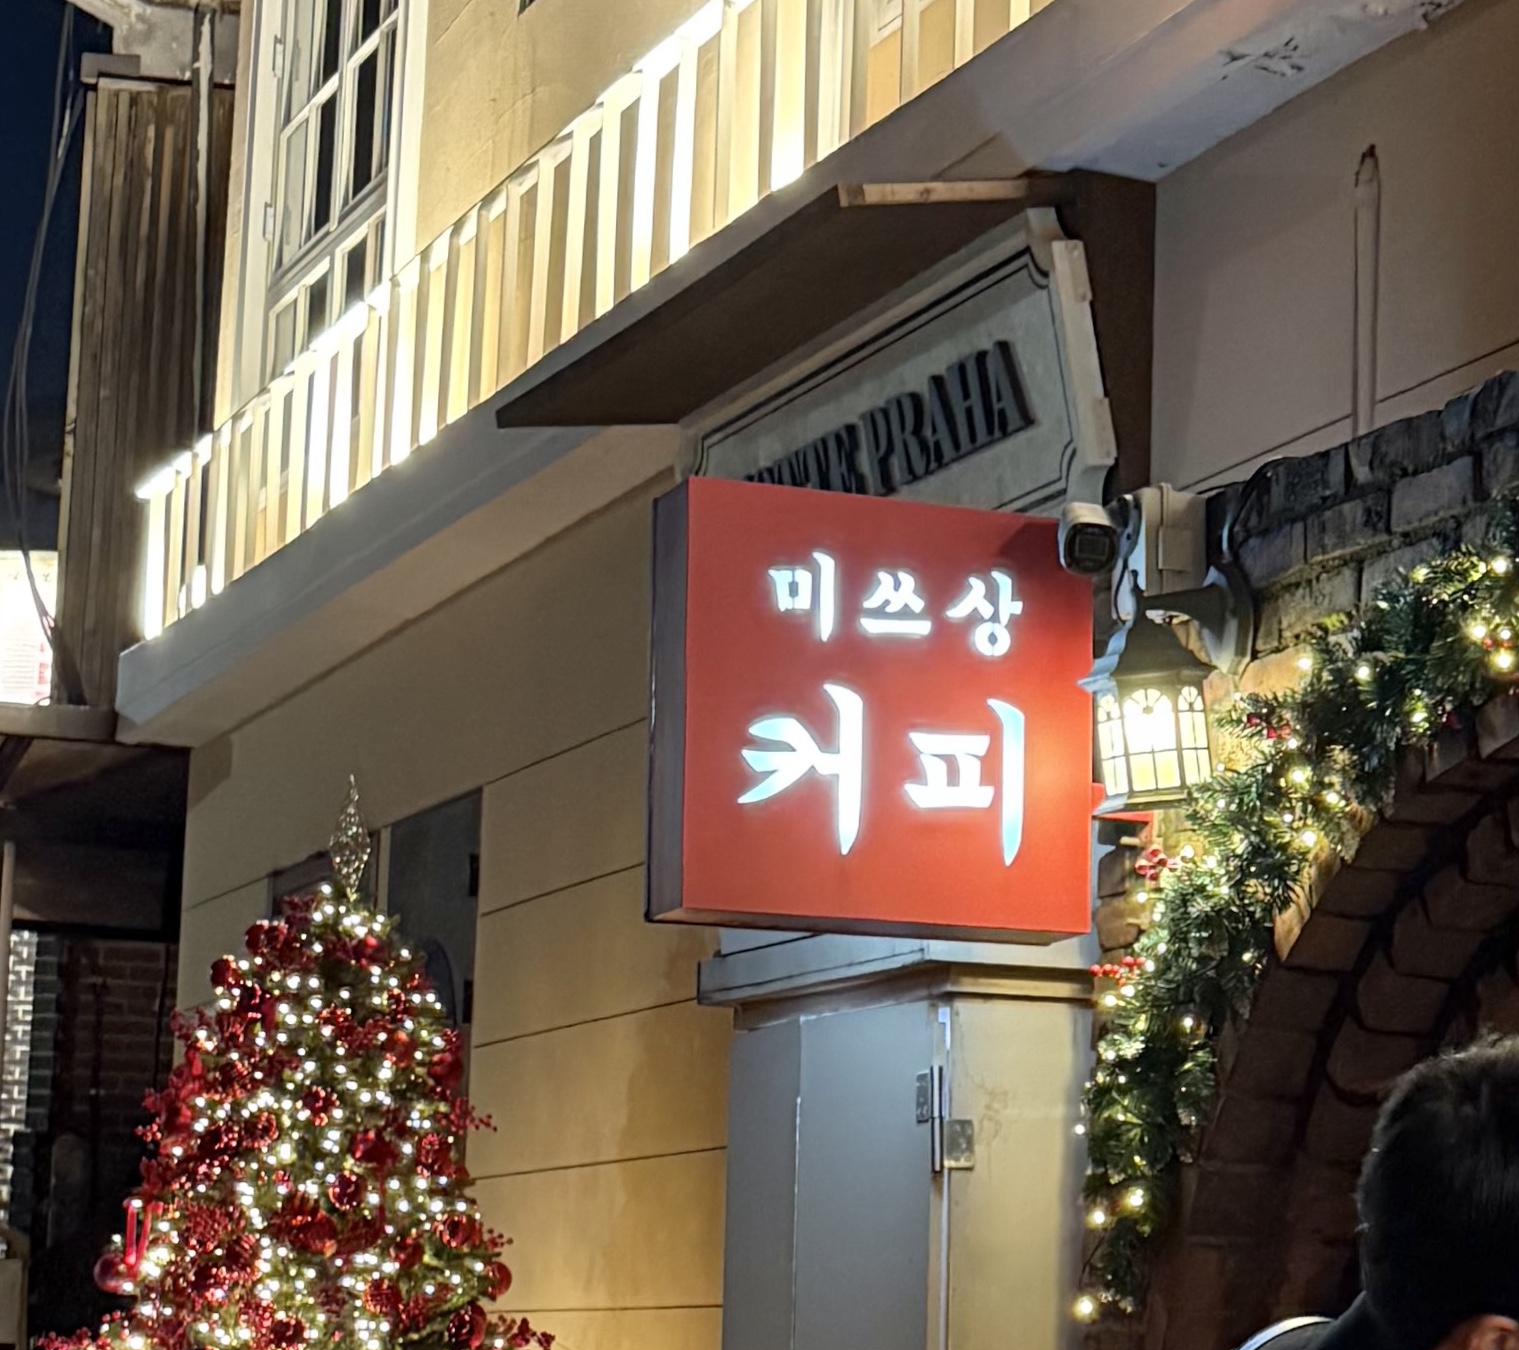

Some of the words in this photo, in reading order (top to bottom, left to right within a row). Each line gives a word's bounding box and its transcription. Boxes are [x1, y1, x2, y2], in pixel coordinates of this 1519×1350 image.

[859, 341, 1036, 498] PRAHA
[768, 551, 1024, 657] 미쓰상
[736, 682, 1026, 867] 커피
